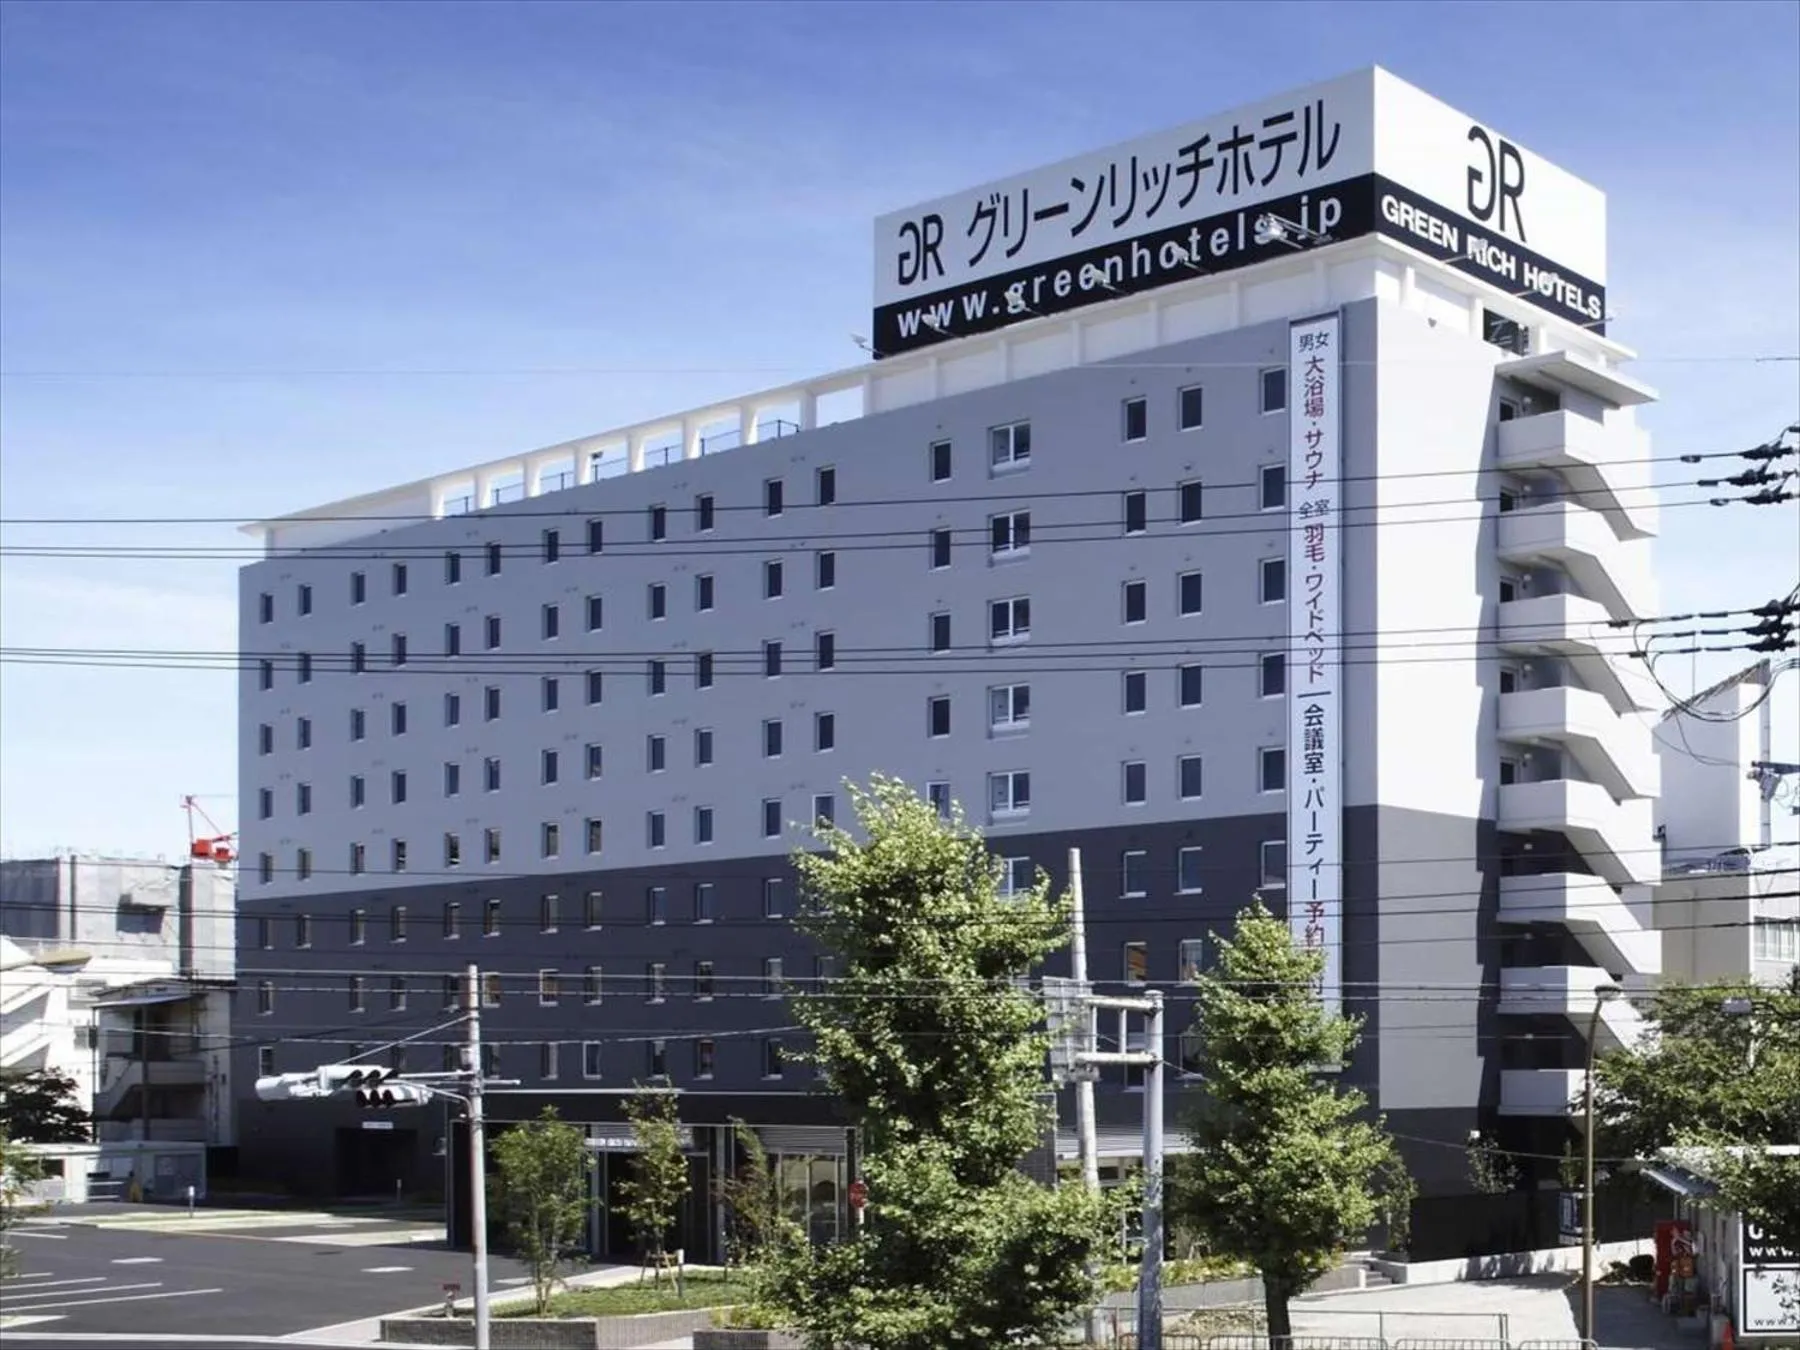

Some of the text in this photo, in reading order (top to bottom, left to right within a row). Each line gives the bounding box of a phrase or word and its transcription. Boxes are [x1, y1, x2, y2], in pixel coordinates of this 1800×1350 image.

[966, 99, 1341, 268] グリーンリッチホテル
[1381, 194, 1602, 320] GREEN RICH HOTELS
[1299, 331, 1331, 354] 男女
[1299, 499, 1331, 520] 全室
